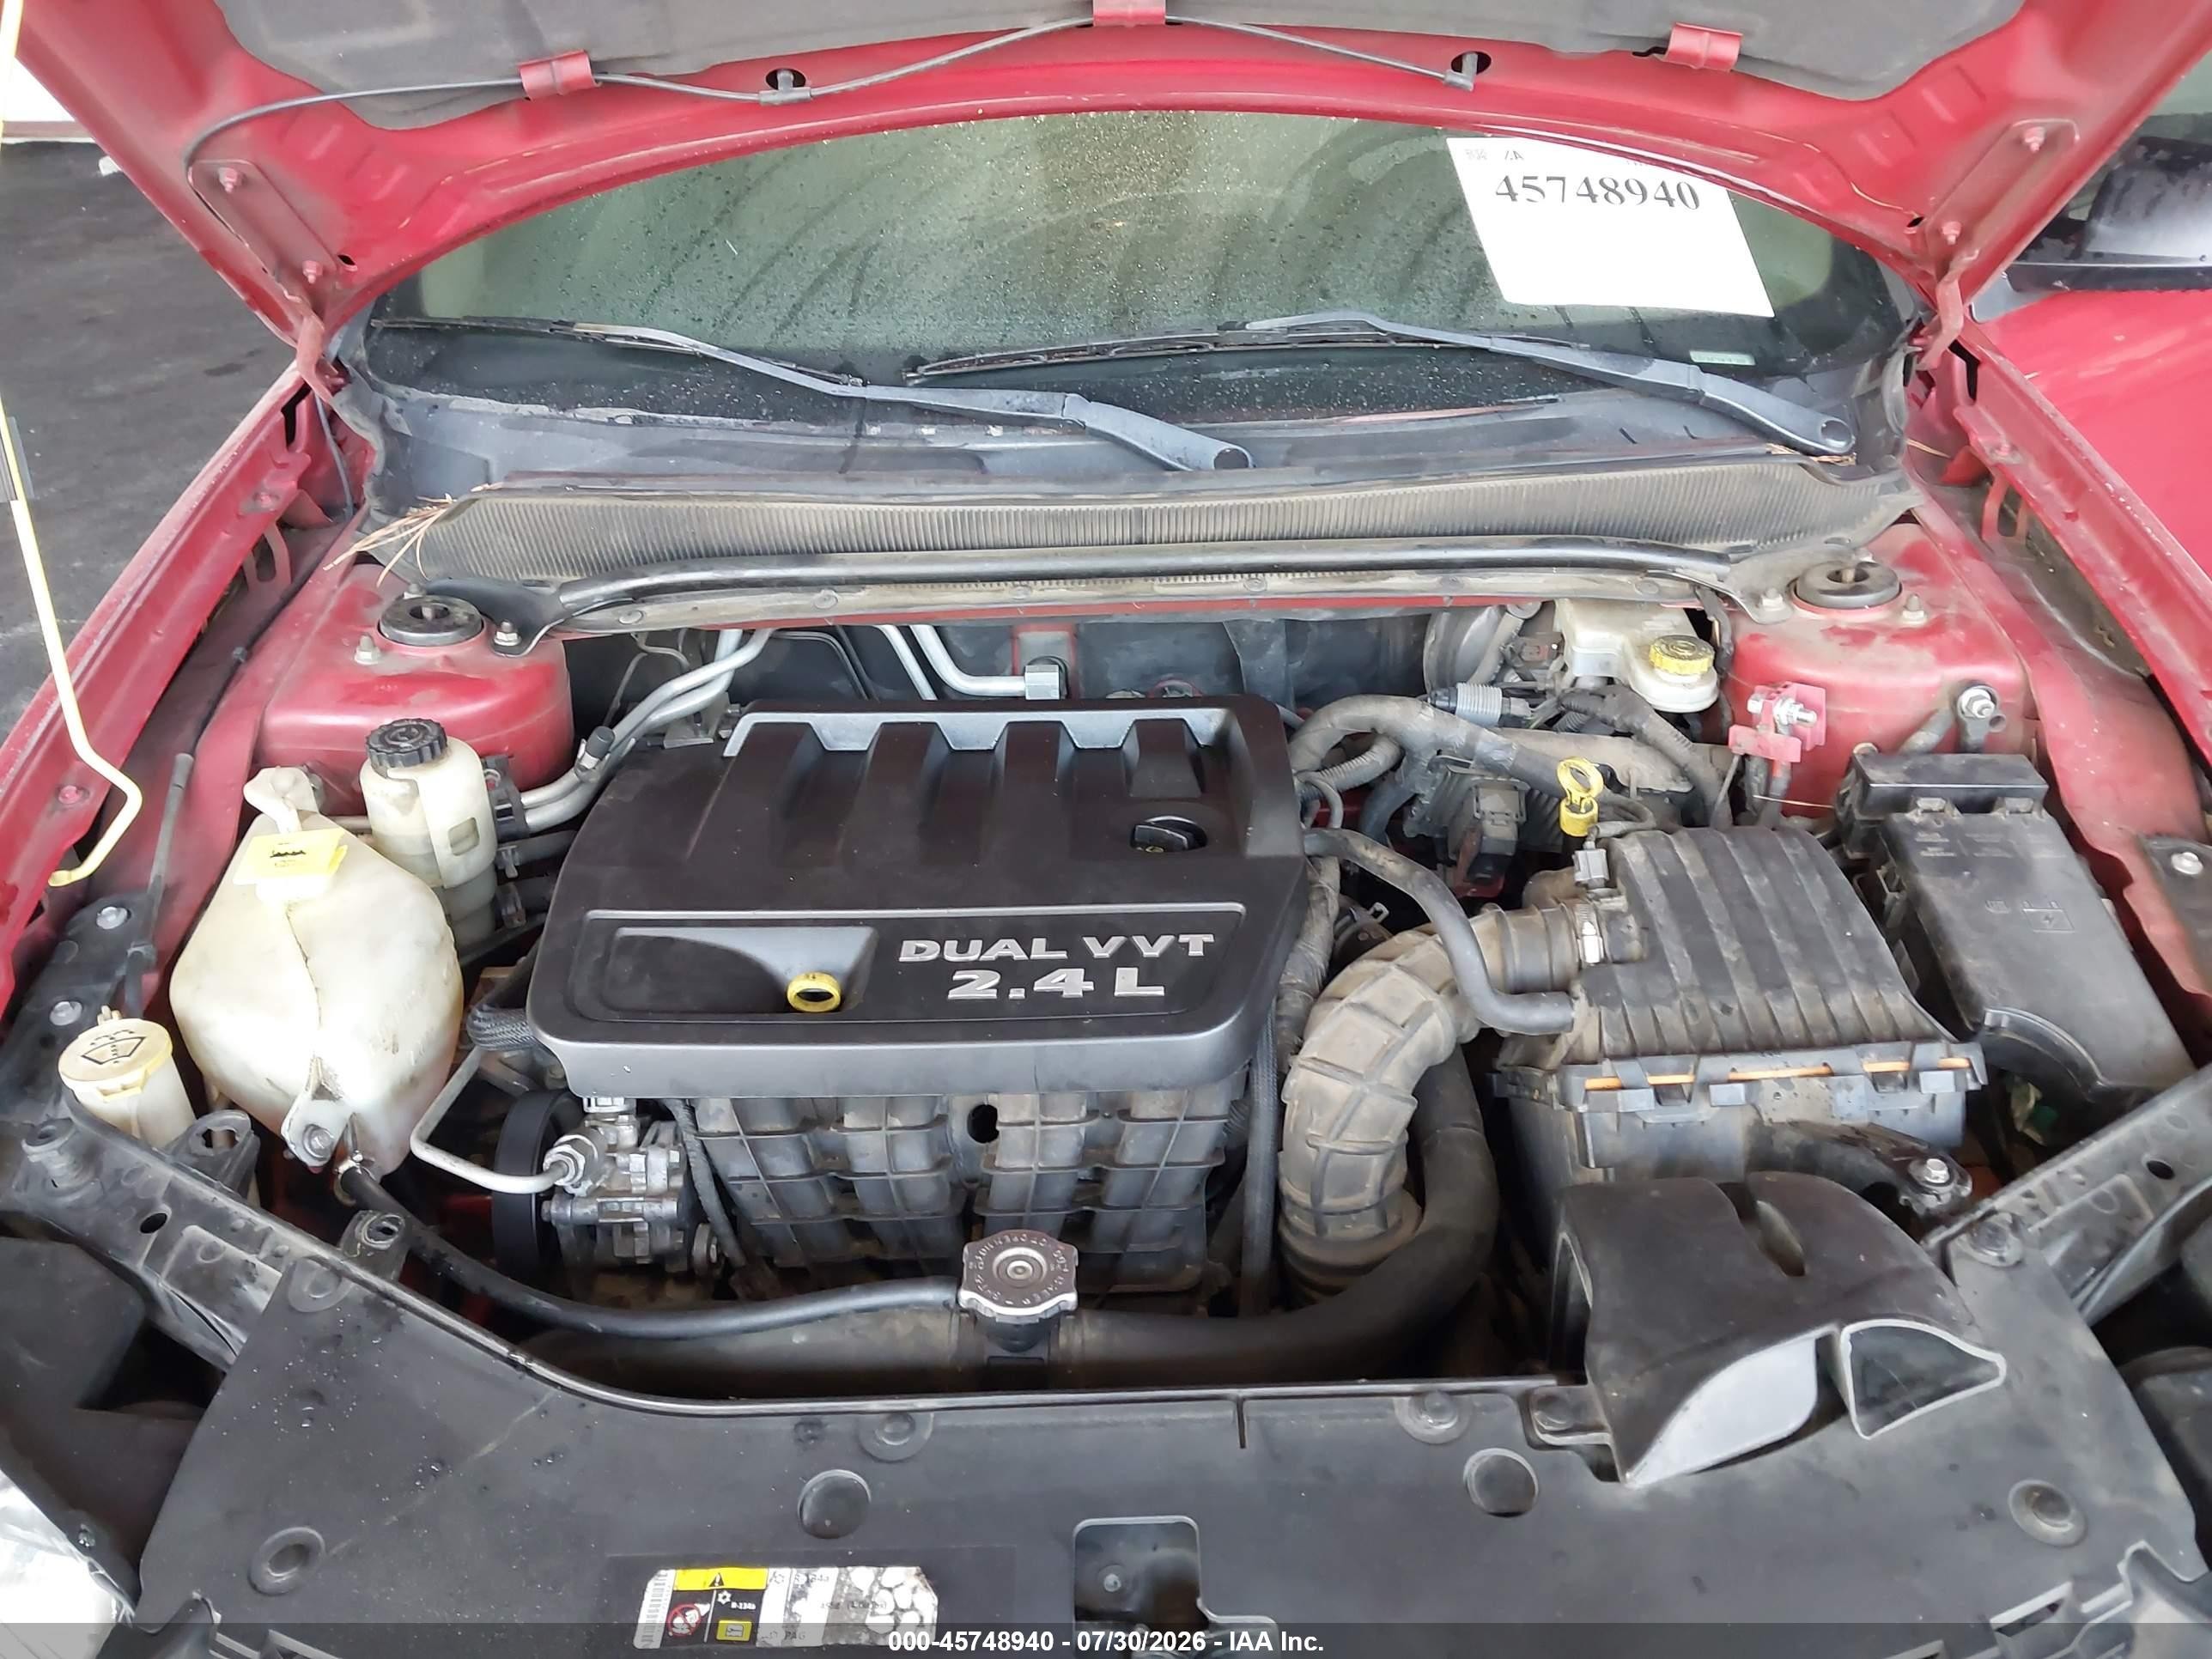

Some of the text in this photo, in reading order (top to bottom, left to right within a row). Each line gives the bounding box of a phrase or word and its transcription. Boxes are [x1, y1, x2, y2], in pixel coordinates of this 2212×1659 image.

[1495, 175, 1700, 210] 45748940
[897, 933, 1215, 963] DUAL VVT
